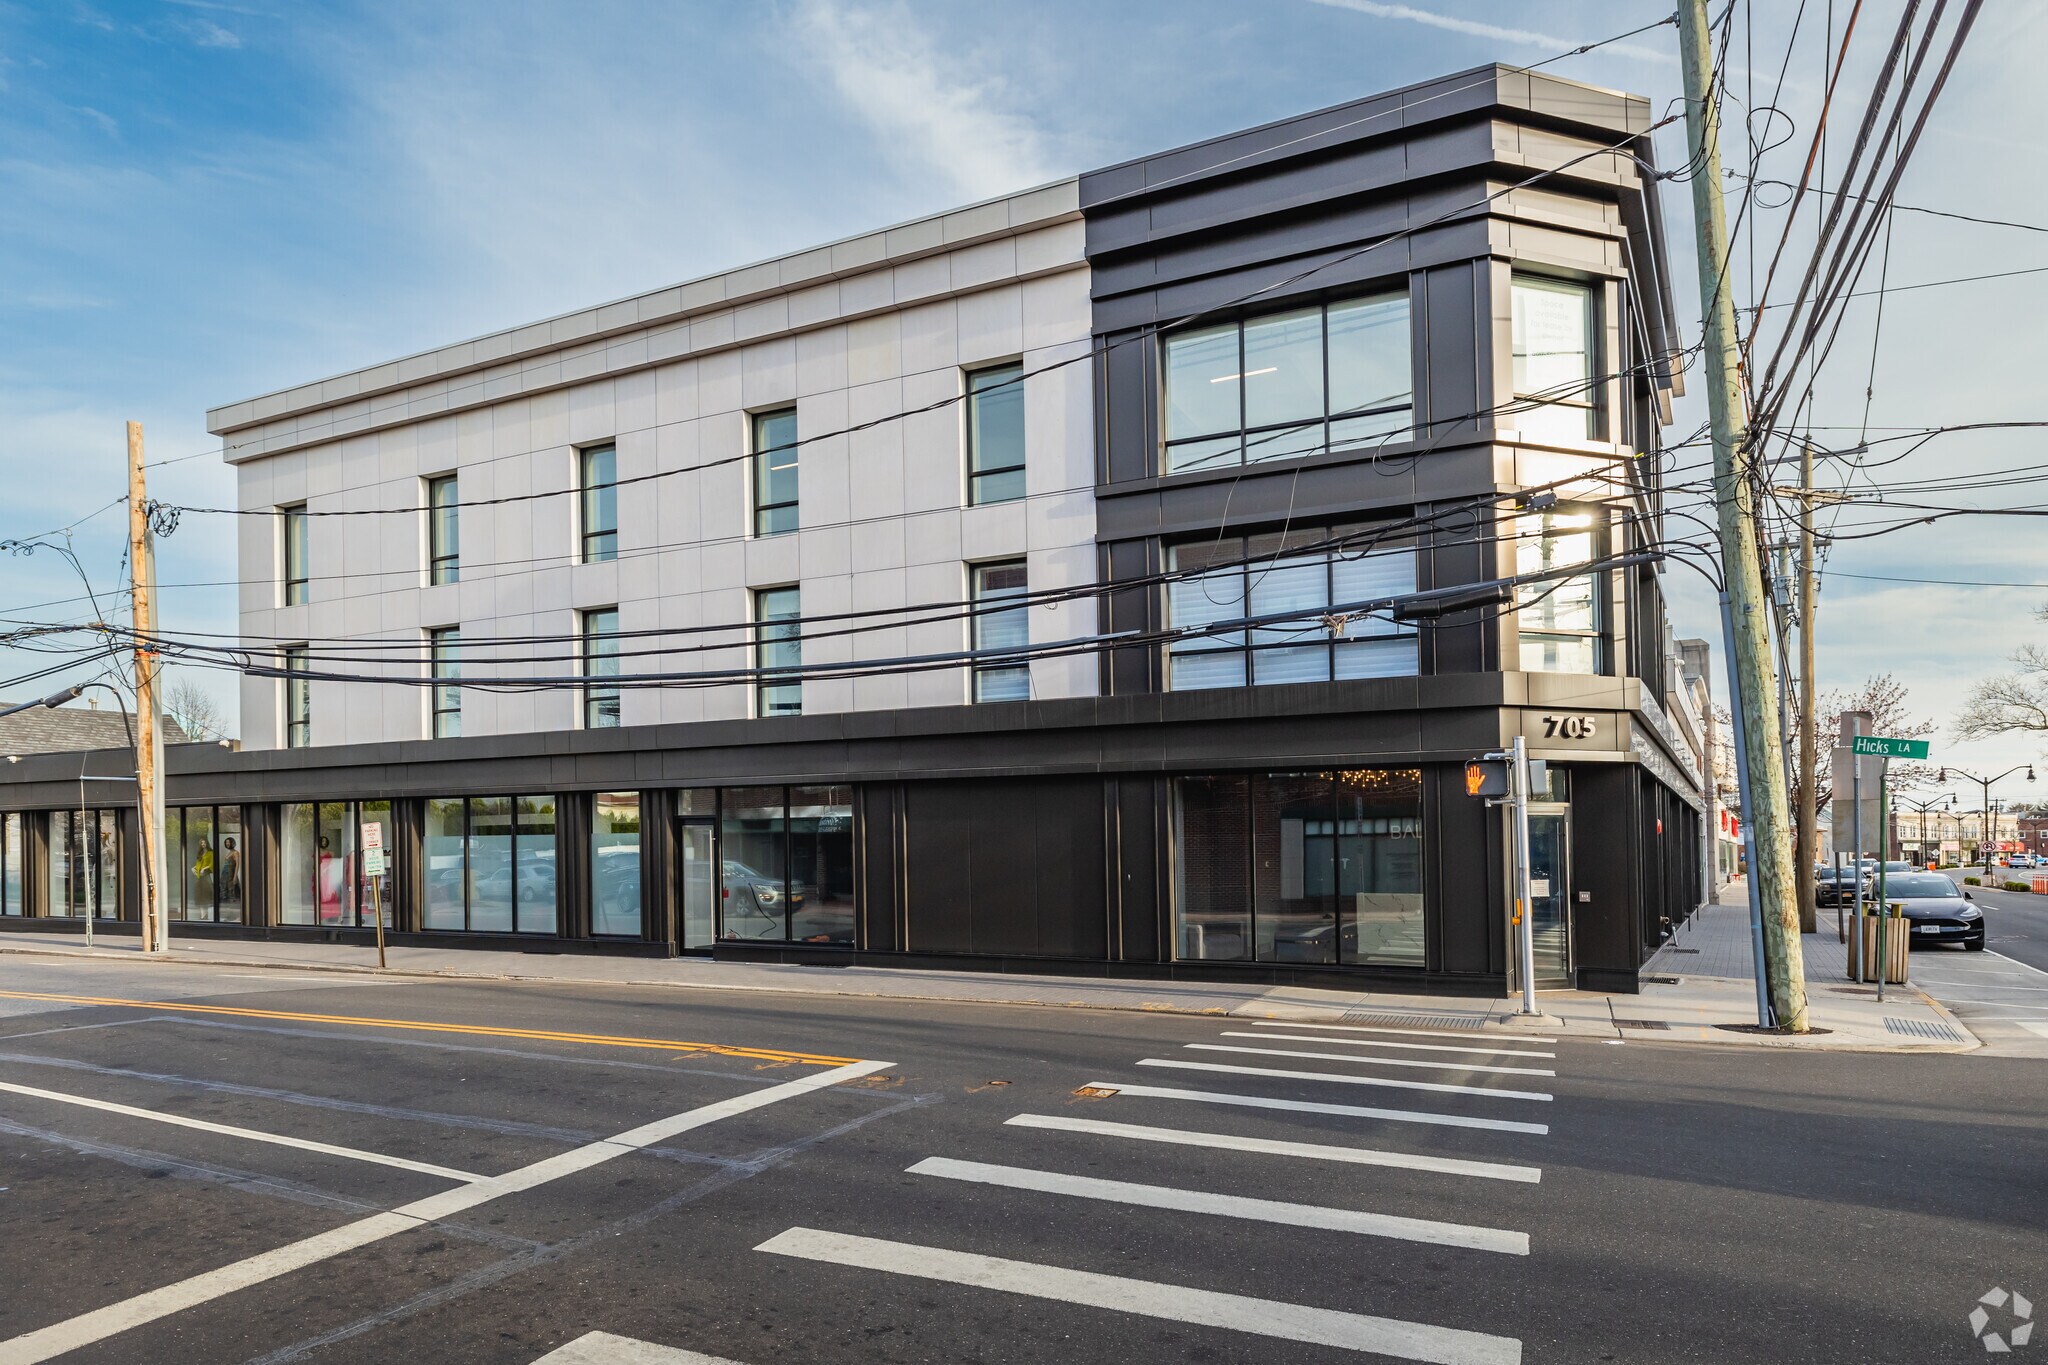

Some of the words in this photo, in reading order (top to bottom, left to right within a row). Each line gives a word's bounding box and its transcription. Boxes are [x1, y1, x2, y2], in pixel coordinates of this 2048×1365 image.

[1547, 715, 1596, 738] 705
[1856, 738, 1889, 754] Hicks
[1898, 743, 1910, 752] LA
